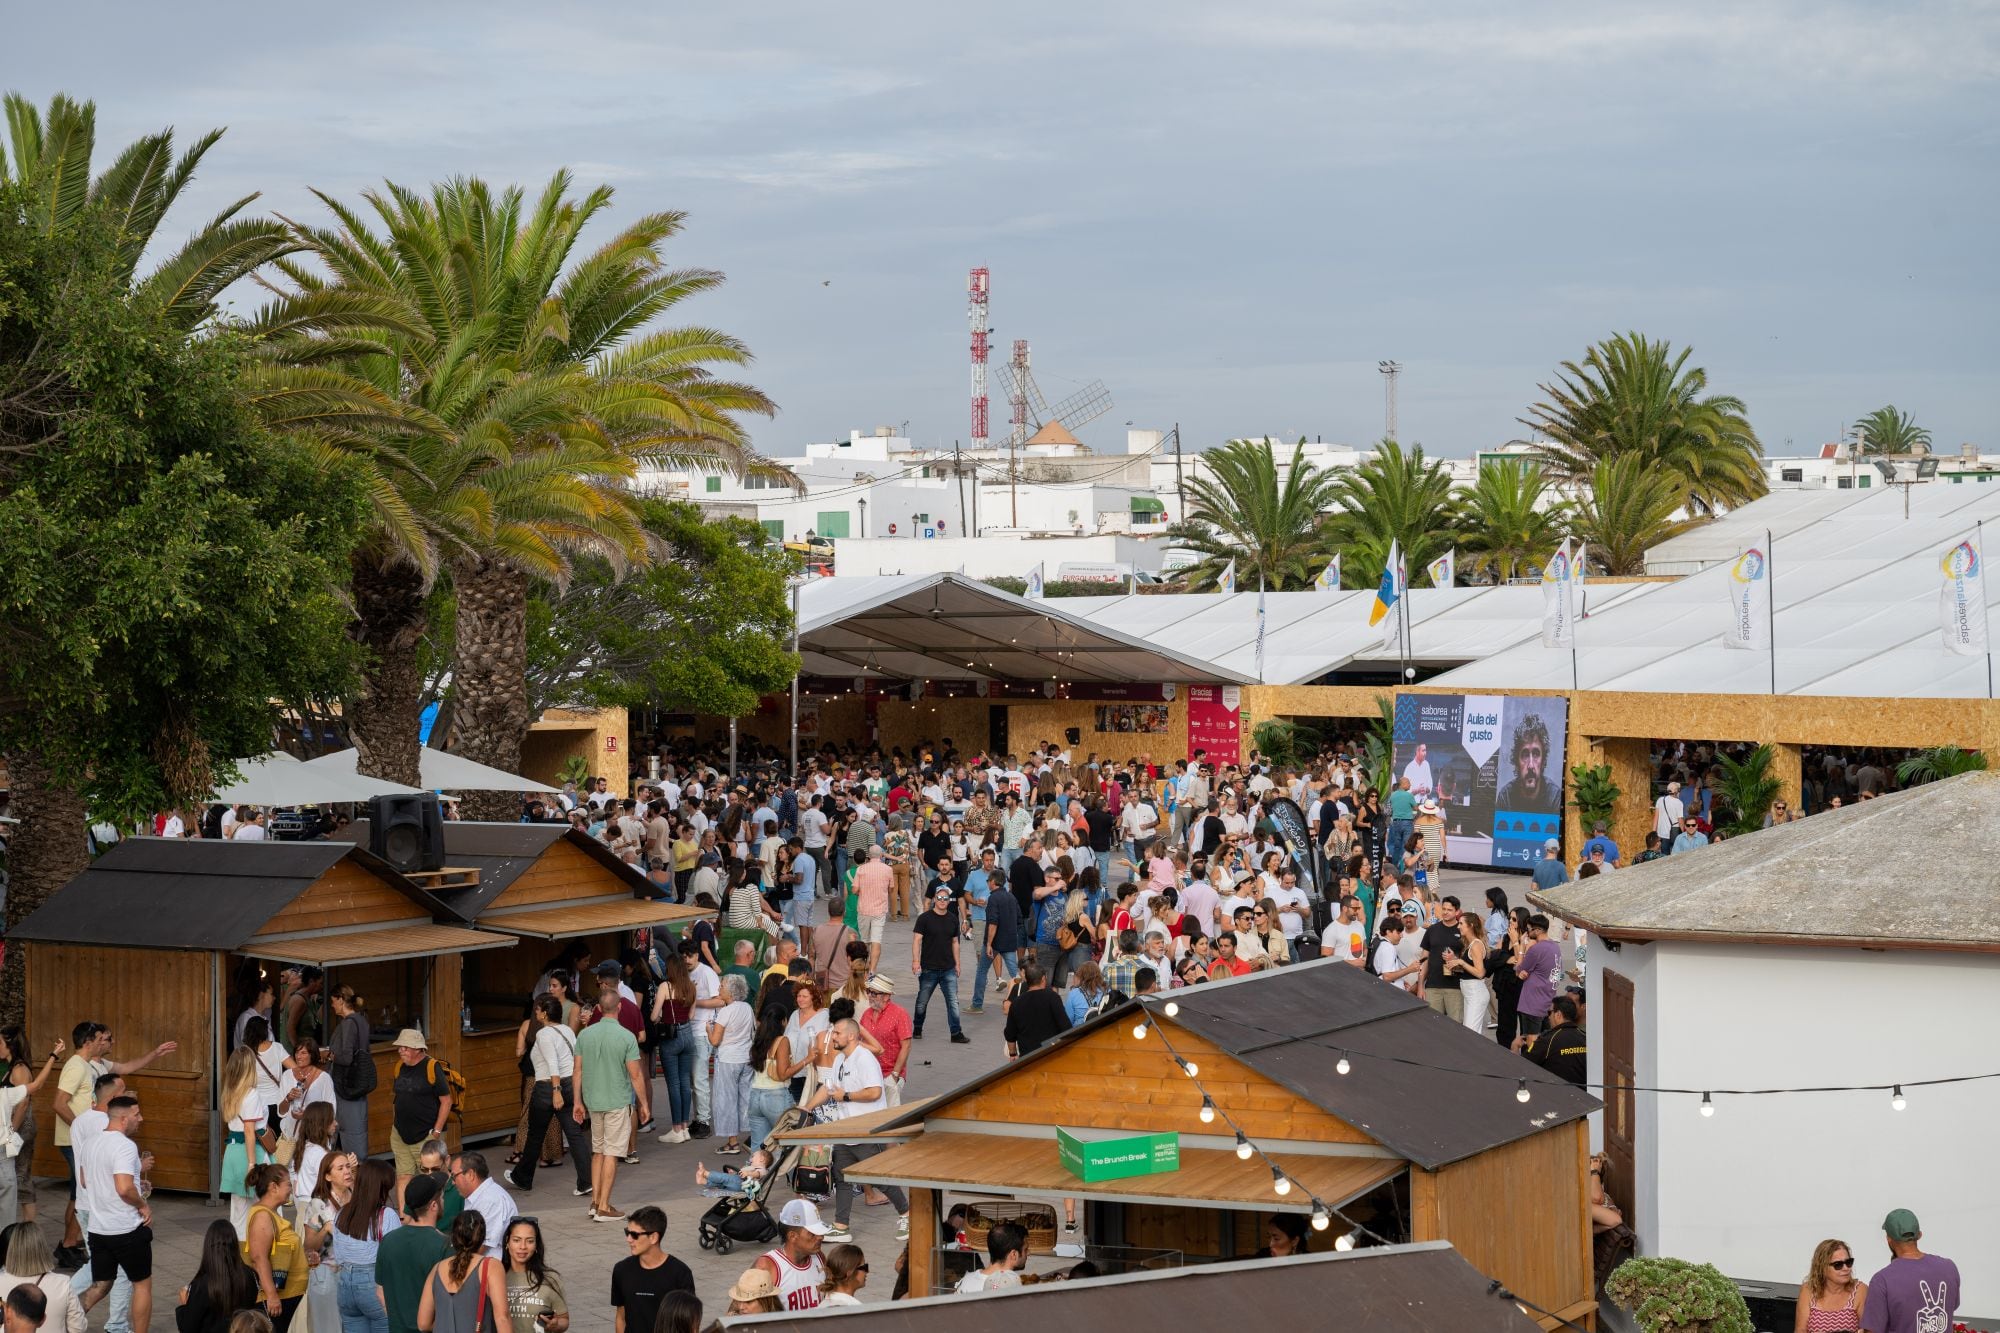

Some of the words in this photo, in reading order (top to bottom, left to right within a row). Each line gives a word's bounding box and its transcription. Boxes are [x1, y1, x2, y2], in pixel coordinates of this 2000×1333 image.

[1421, 704, 1448, 716] saborea
[1466, 713, 1484, 725] Aula
[1485, 713, 1497, 725] del
[1420, 721, 1447, 731] FESTIVAL
[1469, 731, 1493, 743] gusto
[1560, 1047, 1587, 1055] PROSEGU
[1090, 1157, 1104, 1166] The
[1104, 1155, 1128, 1164] Brunch
[1128, 1152, 1147, 1161] Break
[518, 1297, 544, 1306] TIMES
